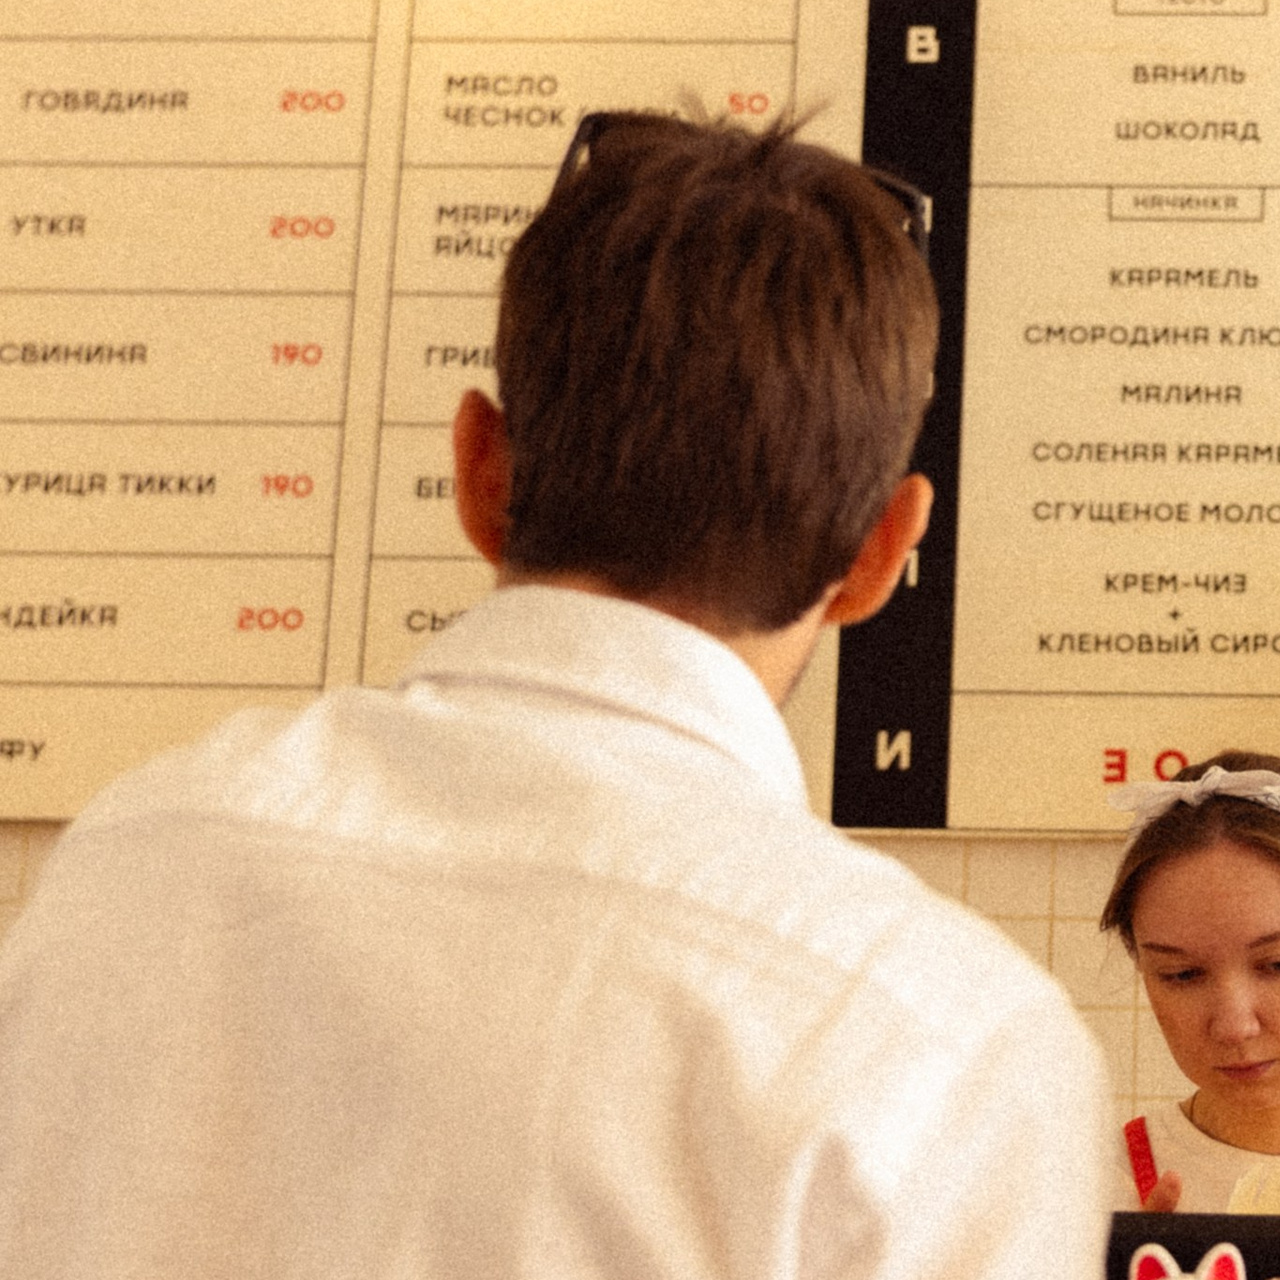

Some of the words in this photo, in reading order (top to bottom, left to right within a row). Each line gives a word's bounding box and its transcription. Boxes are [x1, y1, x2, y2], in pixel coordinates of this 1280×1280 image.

[445, 74, 560, 97] МАСЛО
[1132, 63, 1248, 85] ВАНИЛЬ
[24, 89, 190, 115] ГОВЯДИНА
[279, 89, 348, 113] 200
[444, 105, 566, 129] ЧЕСНОК
[1115, 119, 1263, 144] ШОКОЛАД
[1133, 194, 1239, 211] НАЧИНКА
[13, 214, 88, 236] УТКА
[270, 215, 337, 240] 200
[1109, 267, 1260, 289] КАРАМЕЛЬ
[1024, 324, 1211, 348] СМОРОДИНА
[0, 342, 149, 365] СВИНИНА
[273, 342, 324, 366] 190
[1121, 383, 1244, 405] МАЛИНА
[1031, 441, 1169, 464] СОЛЕНАЯ
[120, 473, 217, 496] ТИККИ
[262, 474, 315, 499] 190
[1032, 500, 1191, 525] СГУЩЕНОЕ
[1105, 572, 1249, 595] КРЕМ-ЧИЗ
[237, 606, 306, 632] 200
[1038, 627, 1202, 655] КЛЕНОВЫЙ
